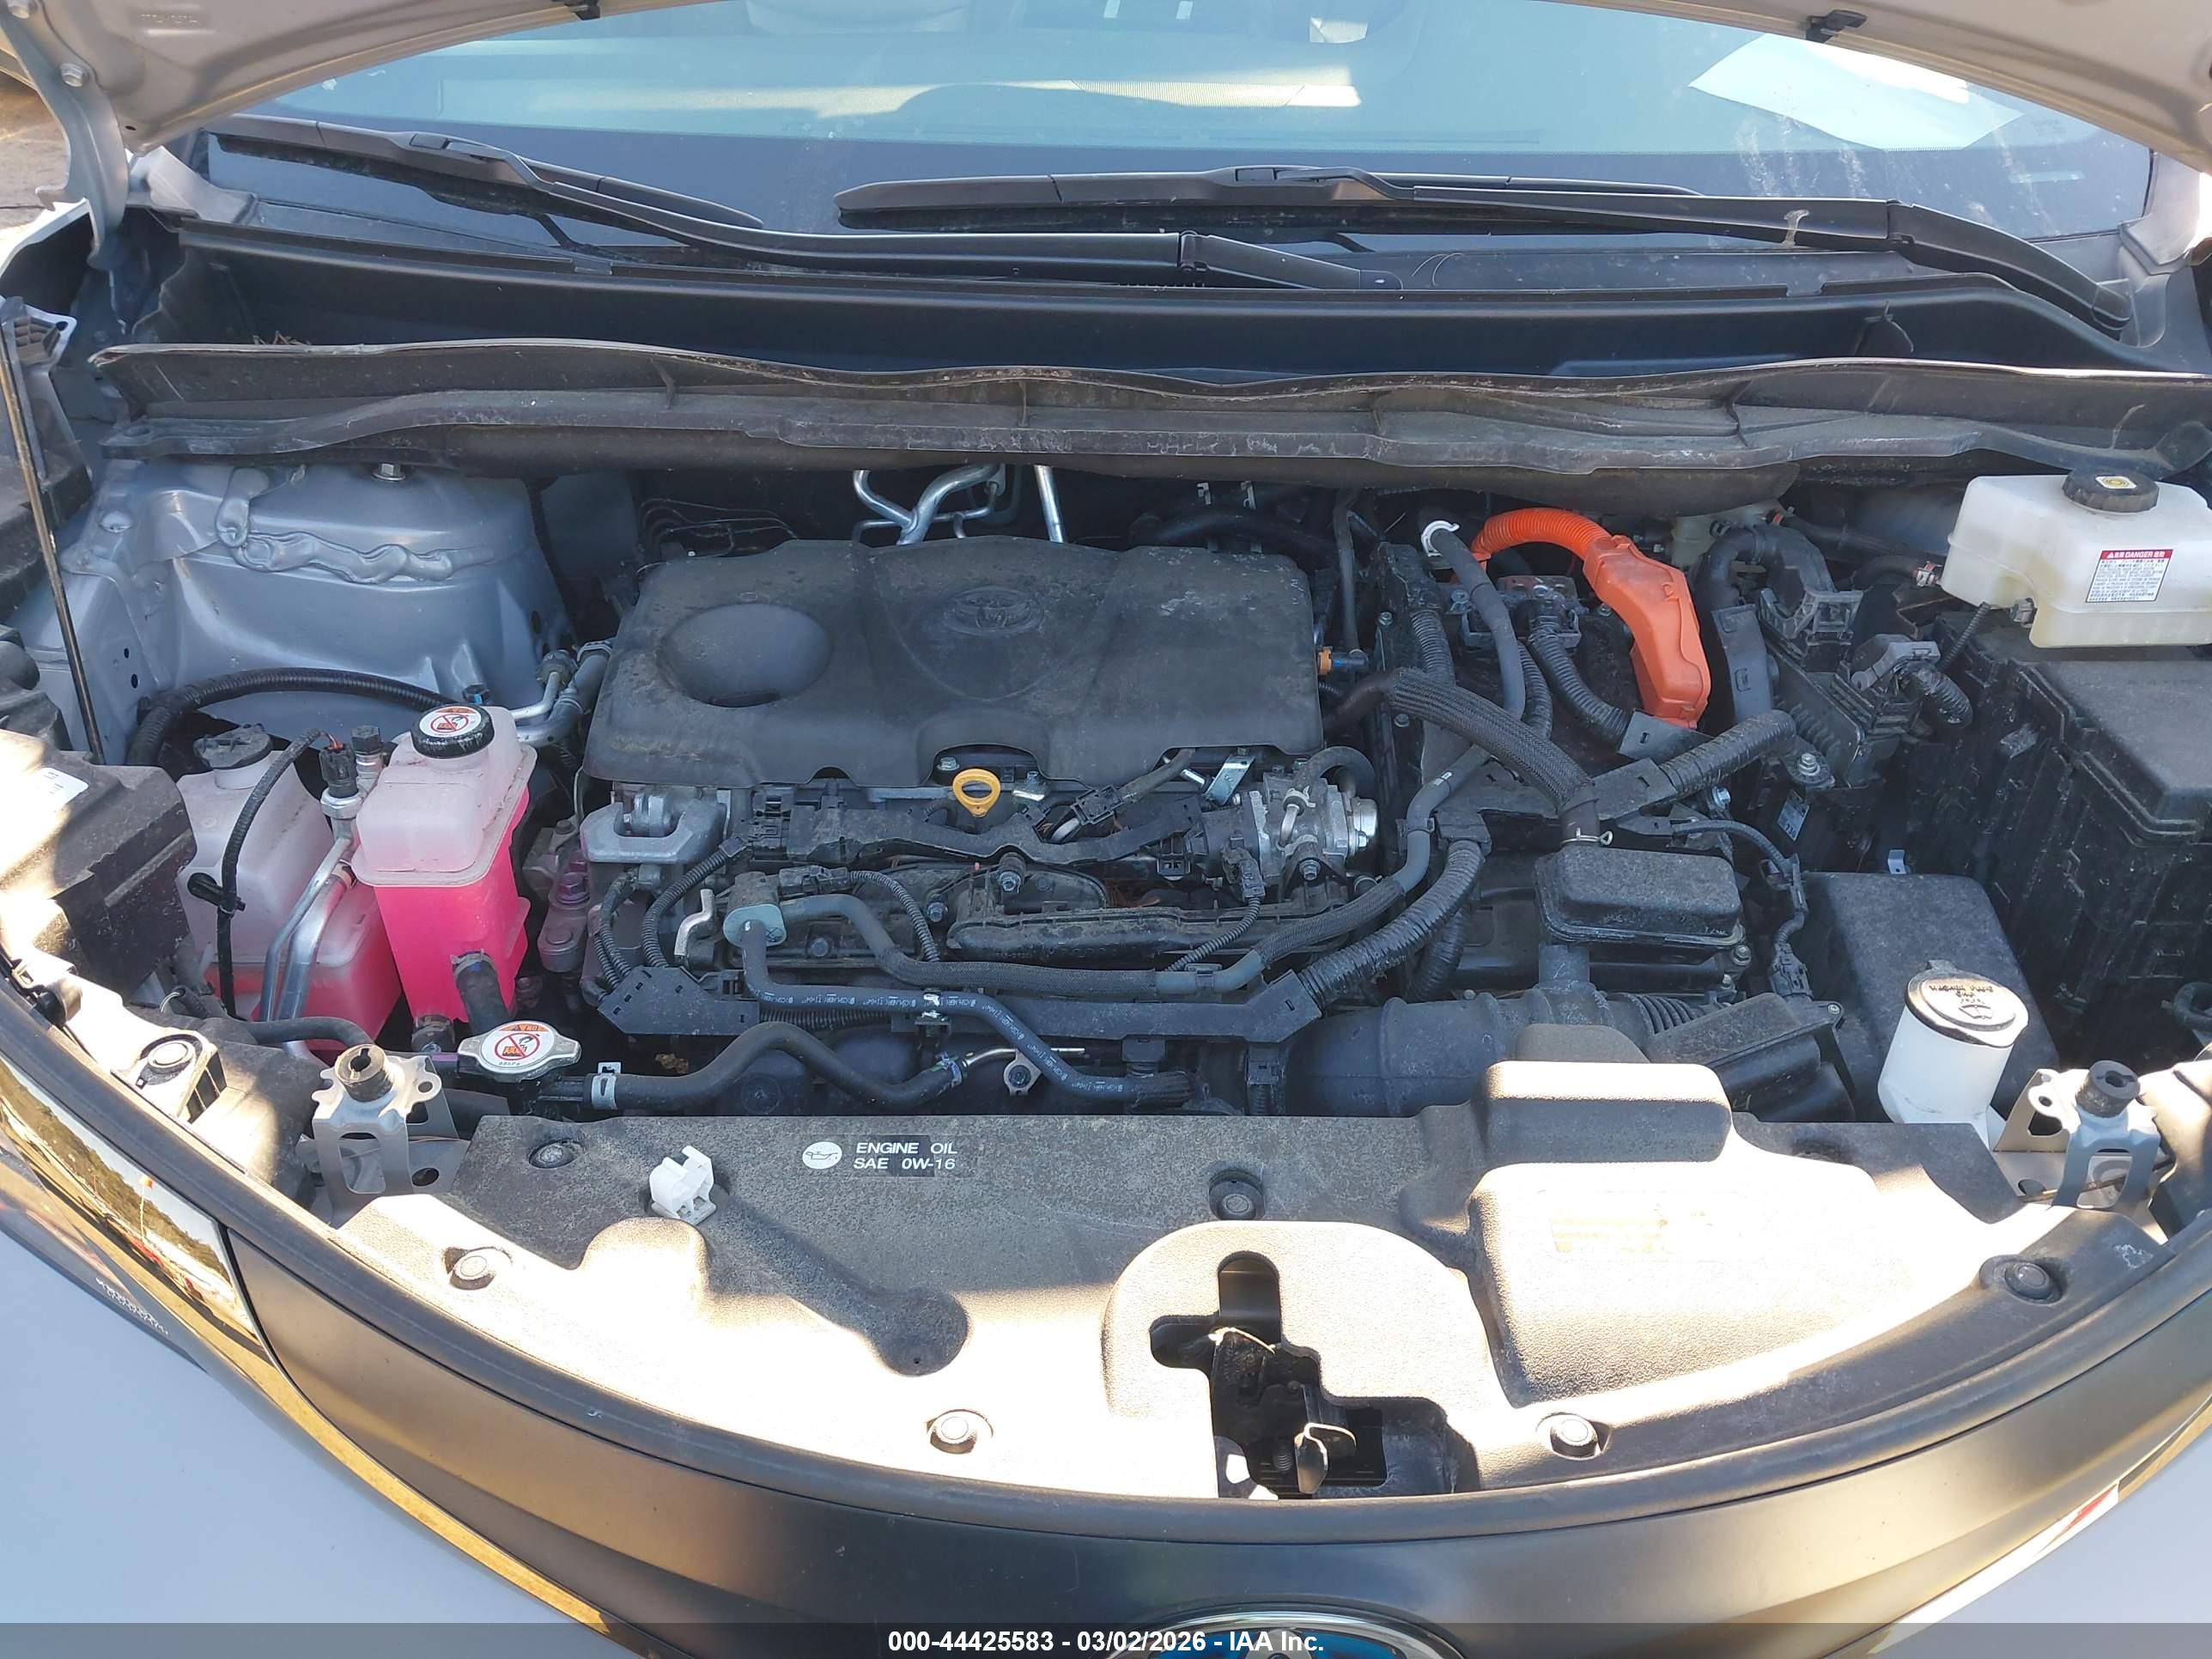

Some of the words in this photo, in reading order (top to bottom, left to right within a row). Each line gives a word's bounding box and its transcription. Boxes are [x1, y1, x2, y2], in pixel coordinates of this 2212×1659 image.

[856, 1142, 920, 1154] ENGINE
[930, 1142, 957, 1154] OIL
[853, 1158, 889, 1170] SAE
[902, 1158, 956, 1170] 0W-16
